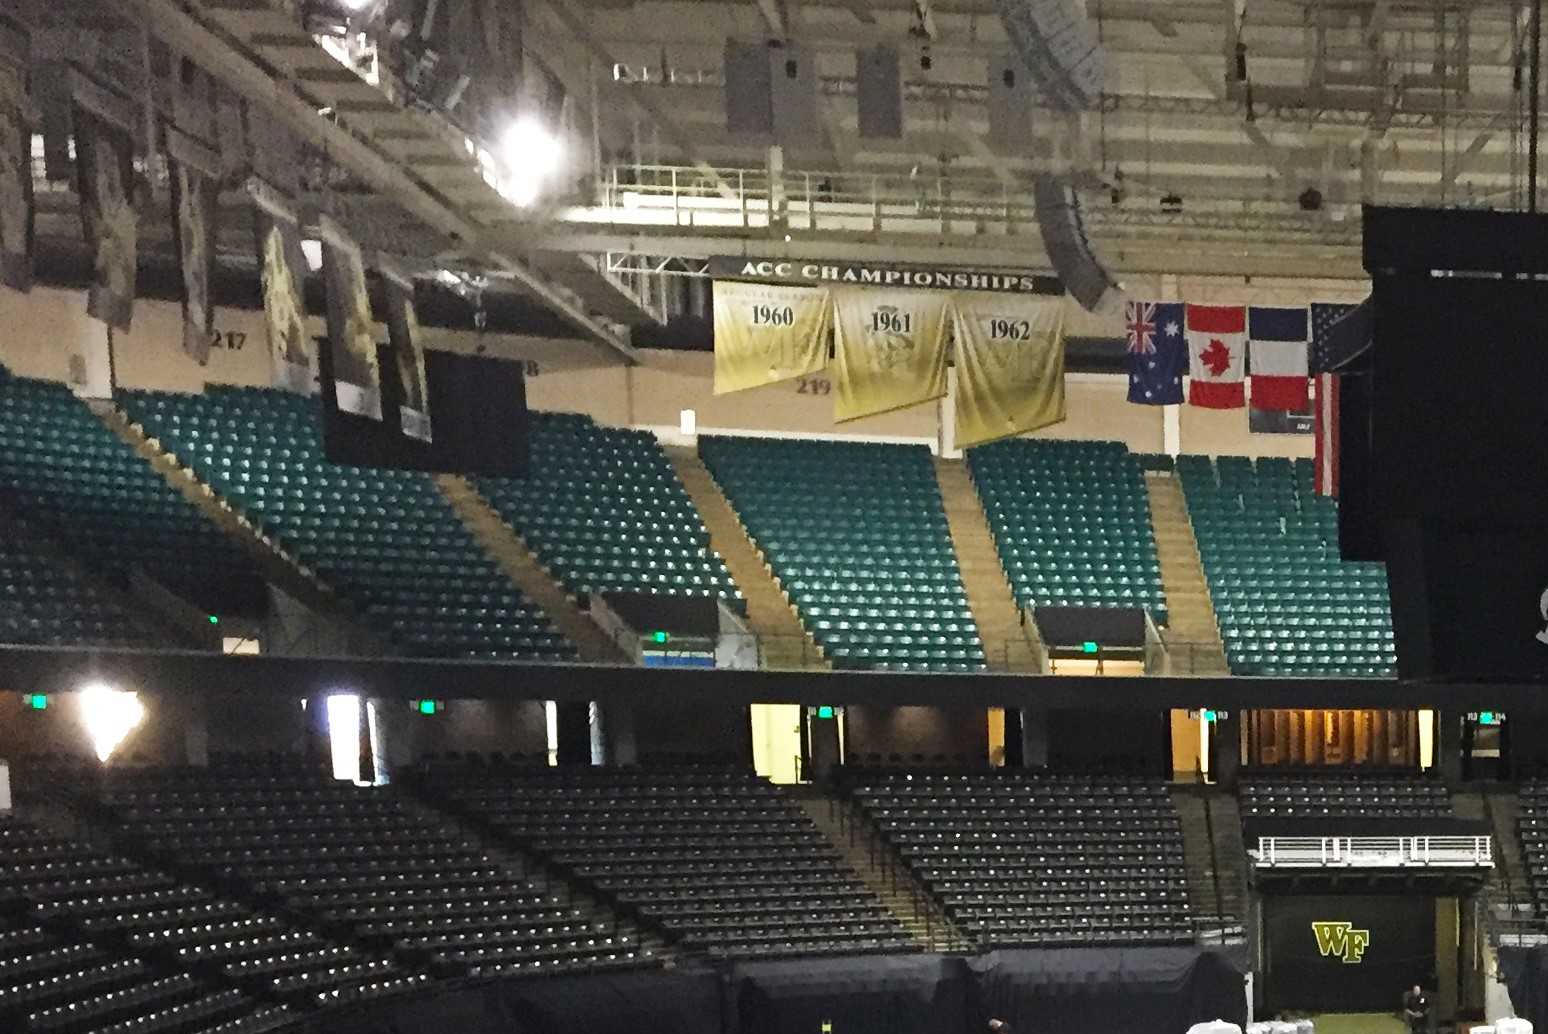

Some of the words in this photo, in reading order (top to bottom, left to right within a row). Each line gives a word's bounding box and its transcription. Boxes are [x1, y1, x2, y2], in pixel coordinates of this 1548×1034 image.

[741, 261, 792, 277] ACC
[801, 264, 1035, 291] CHAMPIONSHIPS
[752, 304, 794, 327] 1960
[871, 311, 912, 334] 1961
[990, 319, 1031, 341] 1962
[1311, 921, 1370, 964] WF
